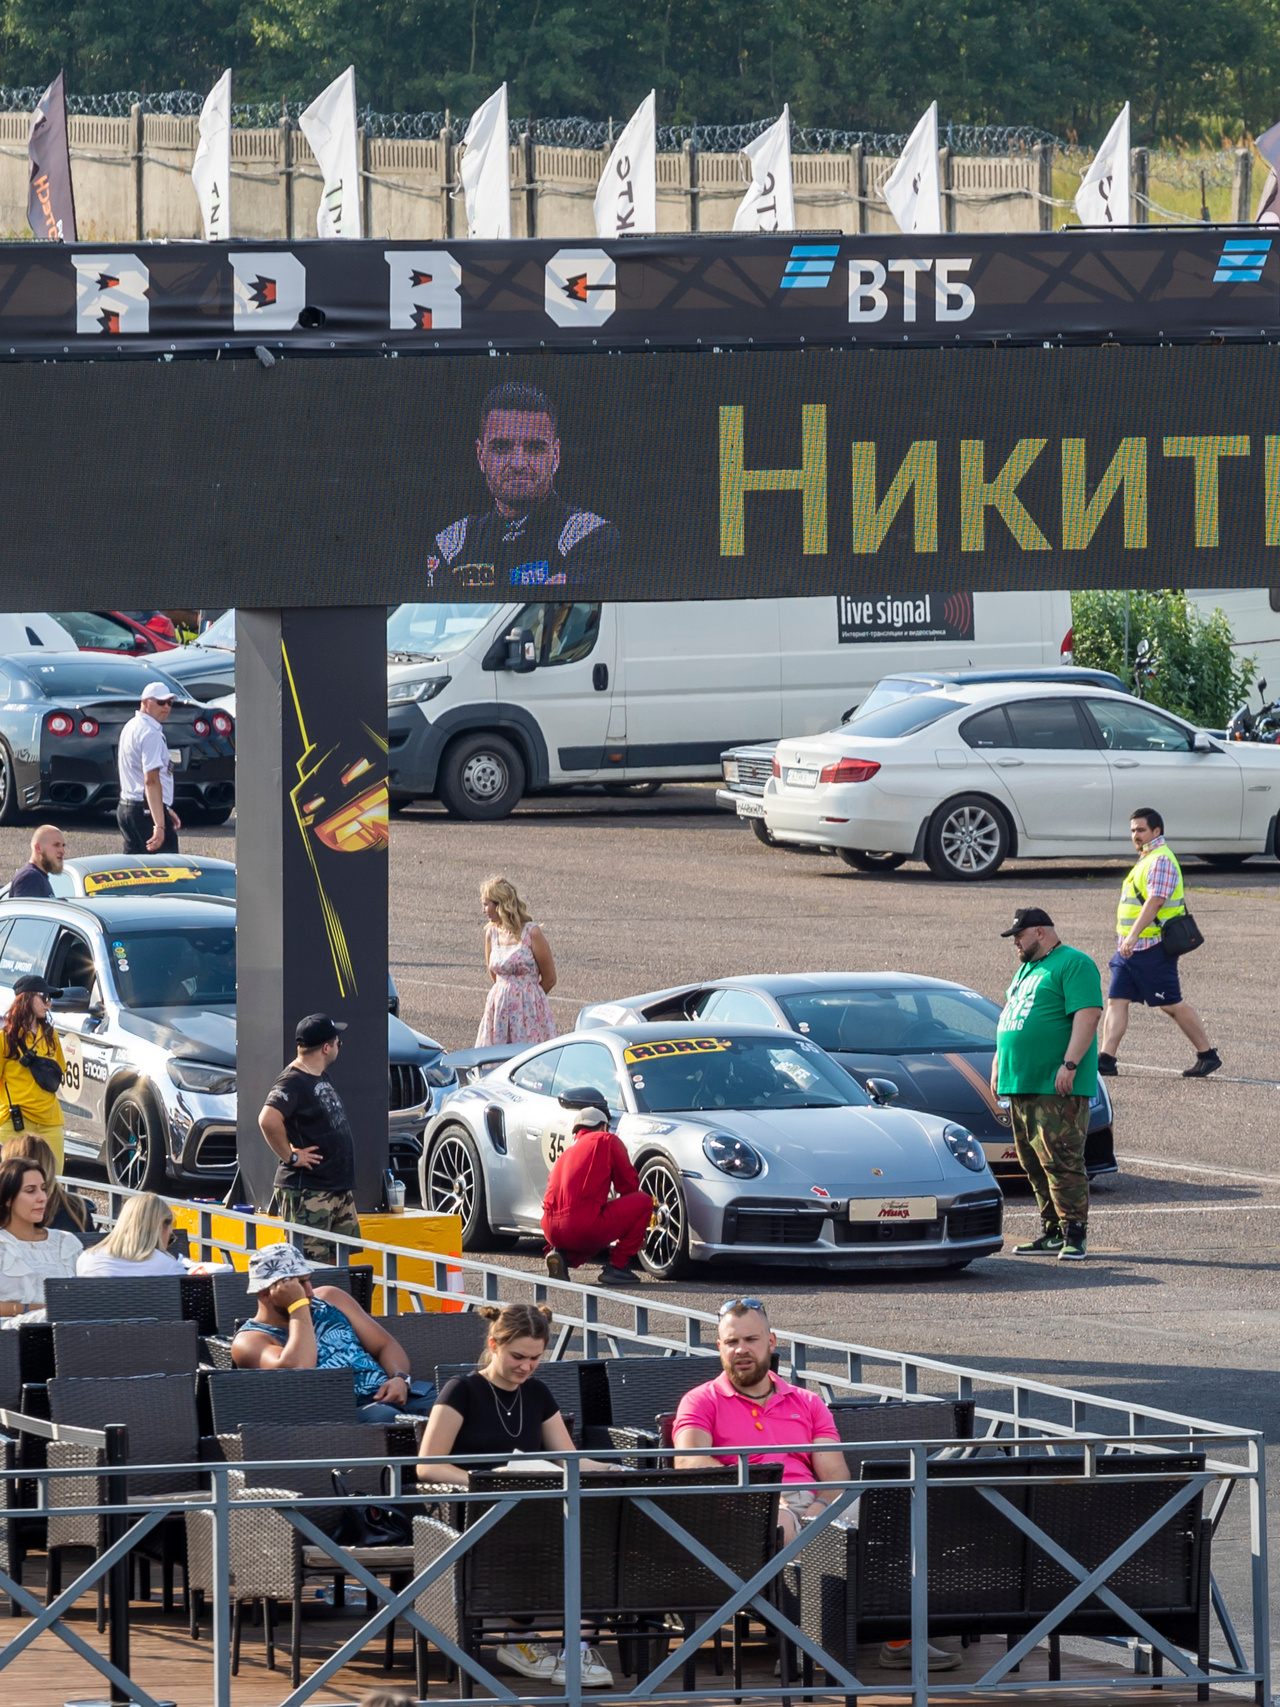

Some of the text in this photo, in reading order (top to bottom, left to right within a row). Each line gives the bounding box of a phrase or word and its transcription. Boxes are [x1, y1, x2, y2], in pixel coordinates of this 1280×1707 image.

[847, 258, 976, 323] ВТБ
[841, 594, 931, 628] live signal
